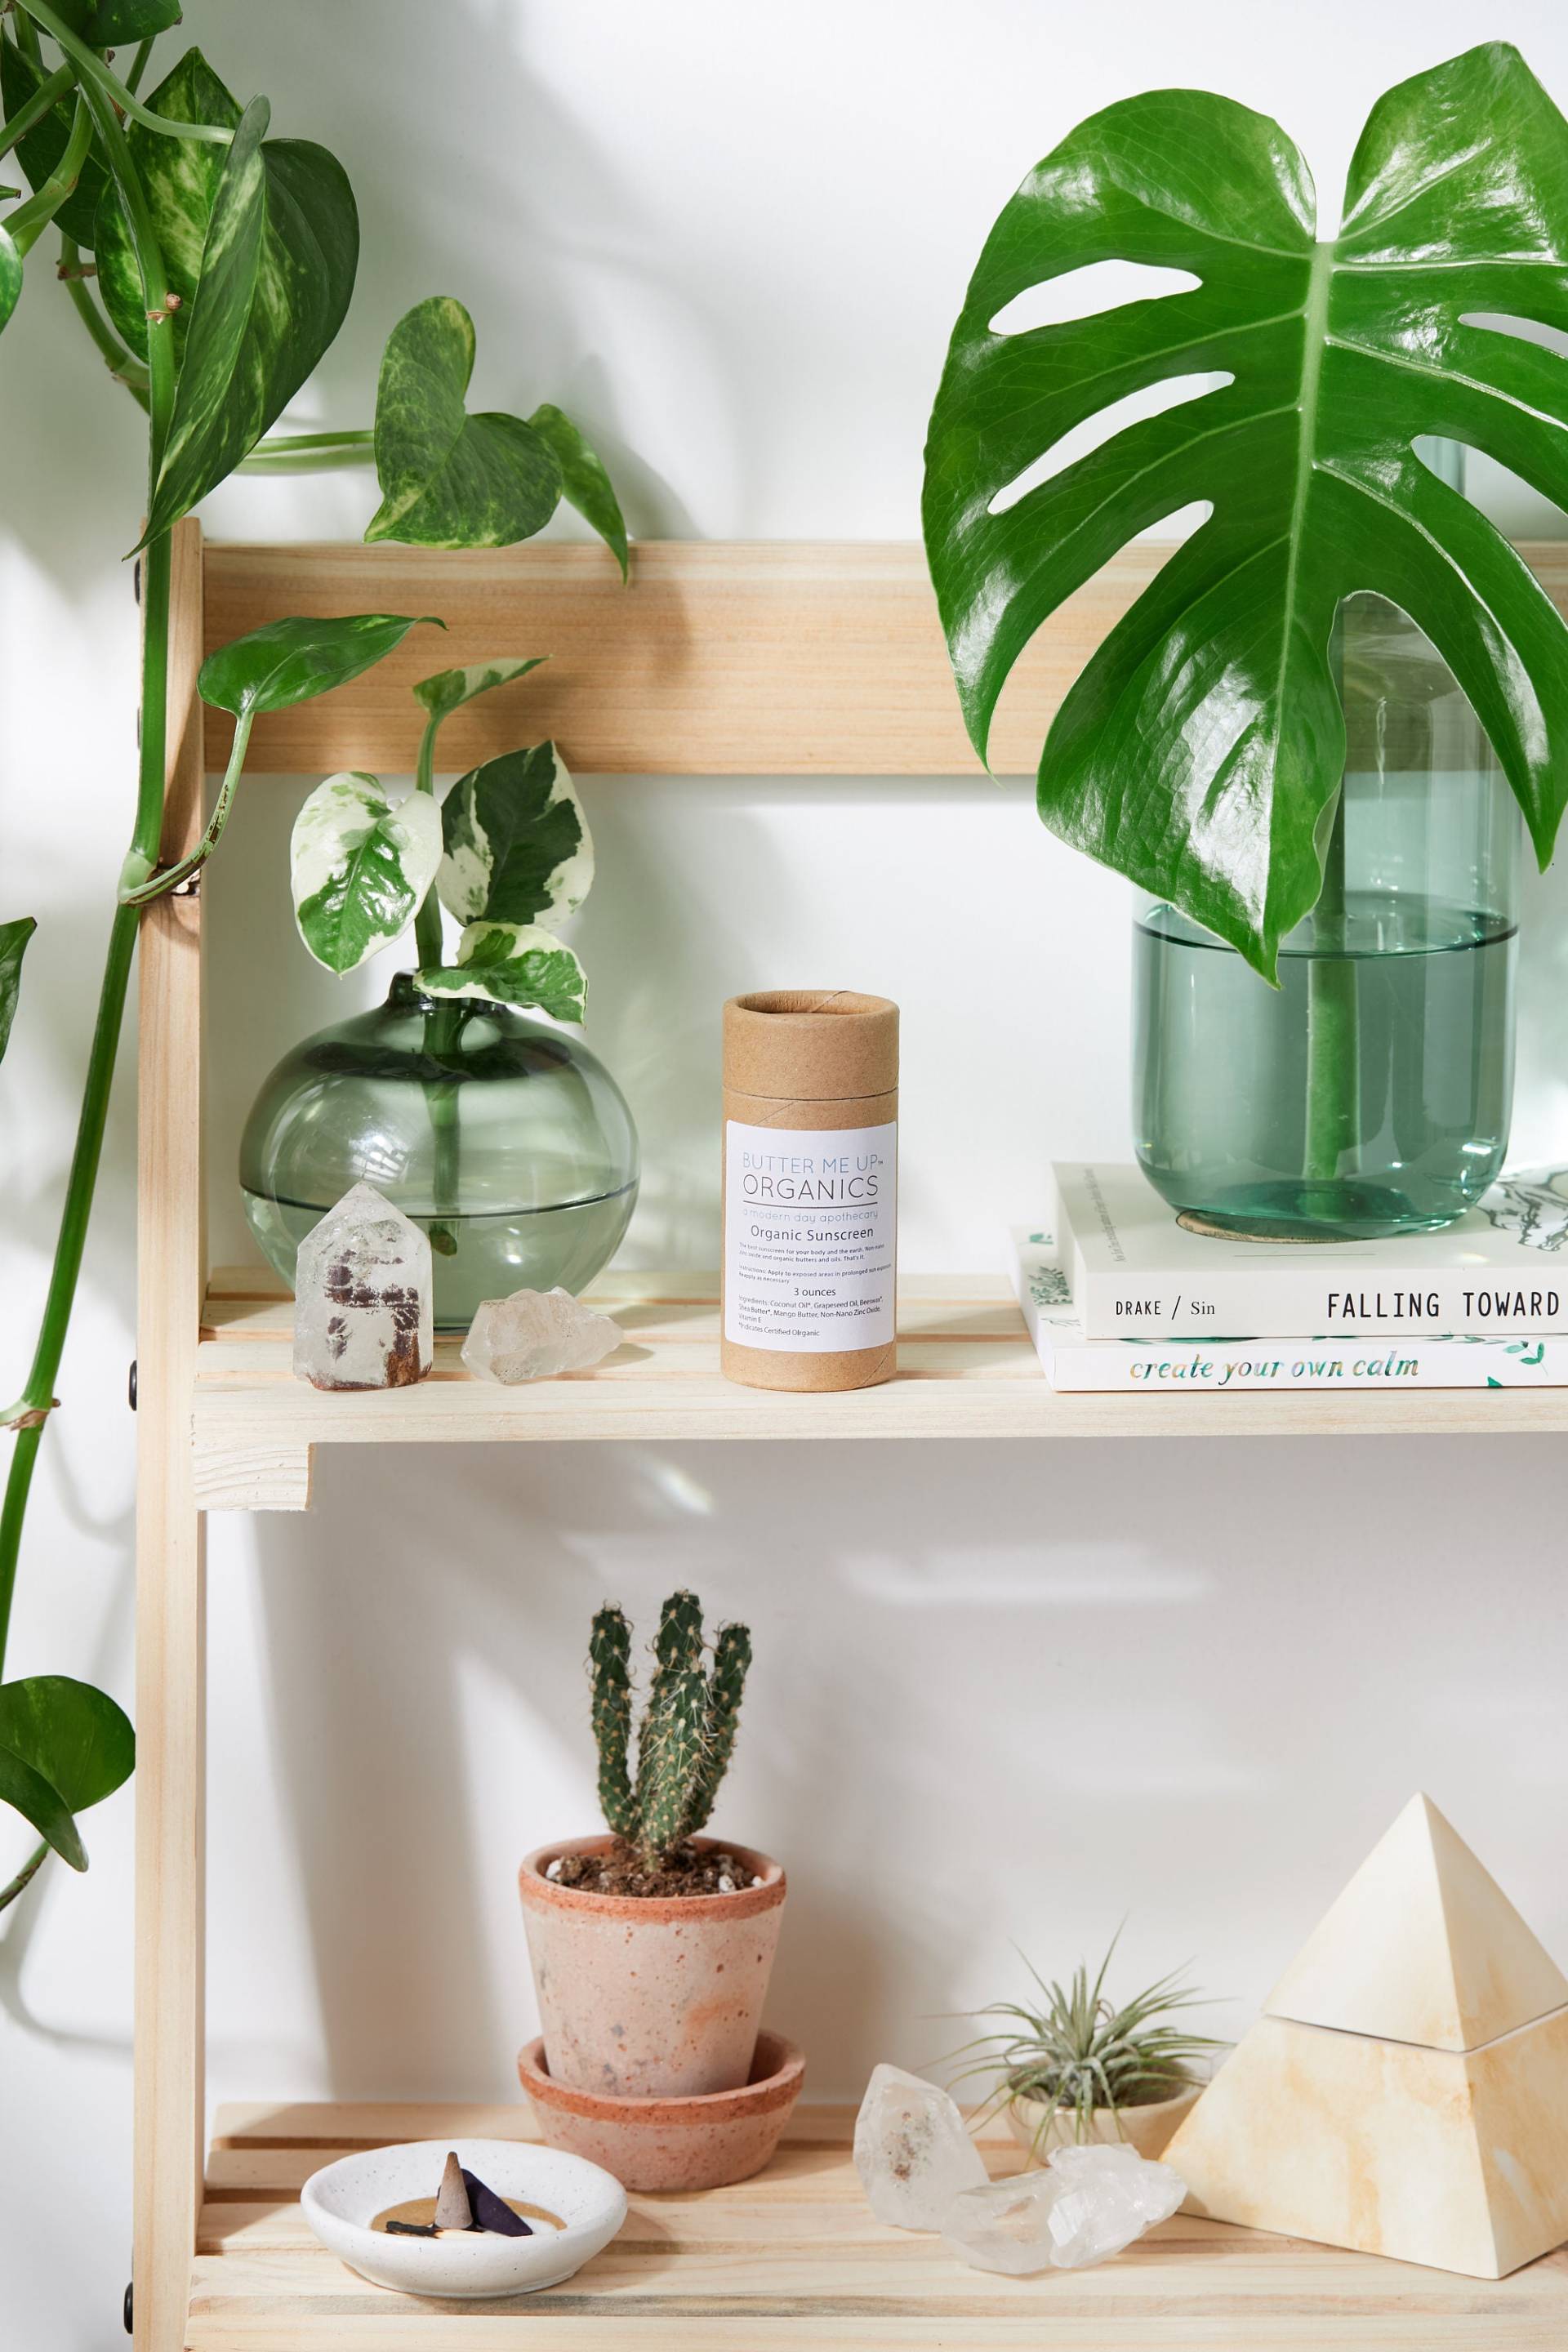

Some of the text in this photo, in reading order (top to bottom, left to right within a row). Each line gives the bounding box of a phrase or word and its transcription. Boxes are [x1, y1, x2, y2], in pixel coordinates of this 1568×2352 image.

[743, 1152, 813, 1174] BUTTER
[822, 1157, 849, 1174] ME
[743, 1174, 878, 1200] ORGANICS
[750, 1208, 791, 1222] modern
[794, 1211, 816, 1224] day
[819, 1210, 878, 1225] apothecary
[751, 1225, 874, 1241] Organic Sunscreen
[842, 1269, 868, 1277] prolonged
[793, 1287, 800, 1296] 3
[814, 1301, 849, 1310] Grapeseed
[1115, 1299, 1162, 1316] DRAKE
[1190, 1299, 1216, 1316] Sin
[1327, 1292, 1440, 1319] FALLING
[1462, 1291, 1561, 1317] TOWARD
[764, 1327, 791, 1335] Certified
[1129, 1349, 1419, 1386] create your own calm
